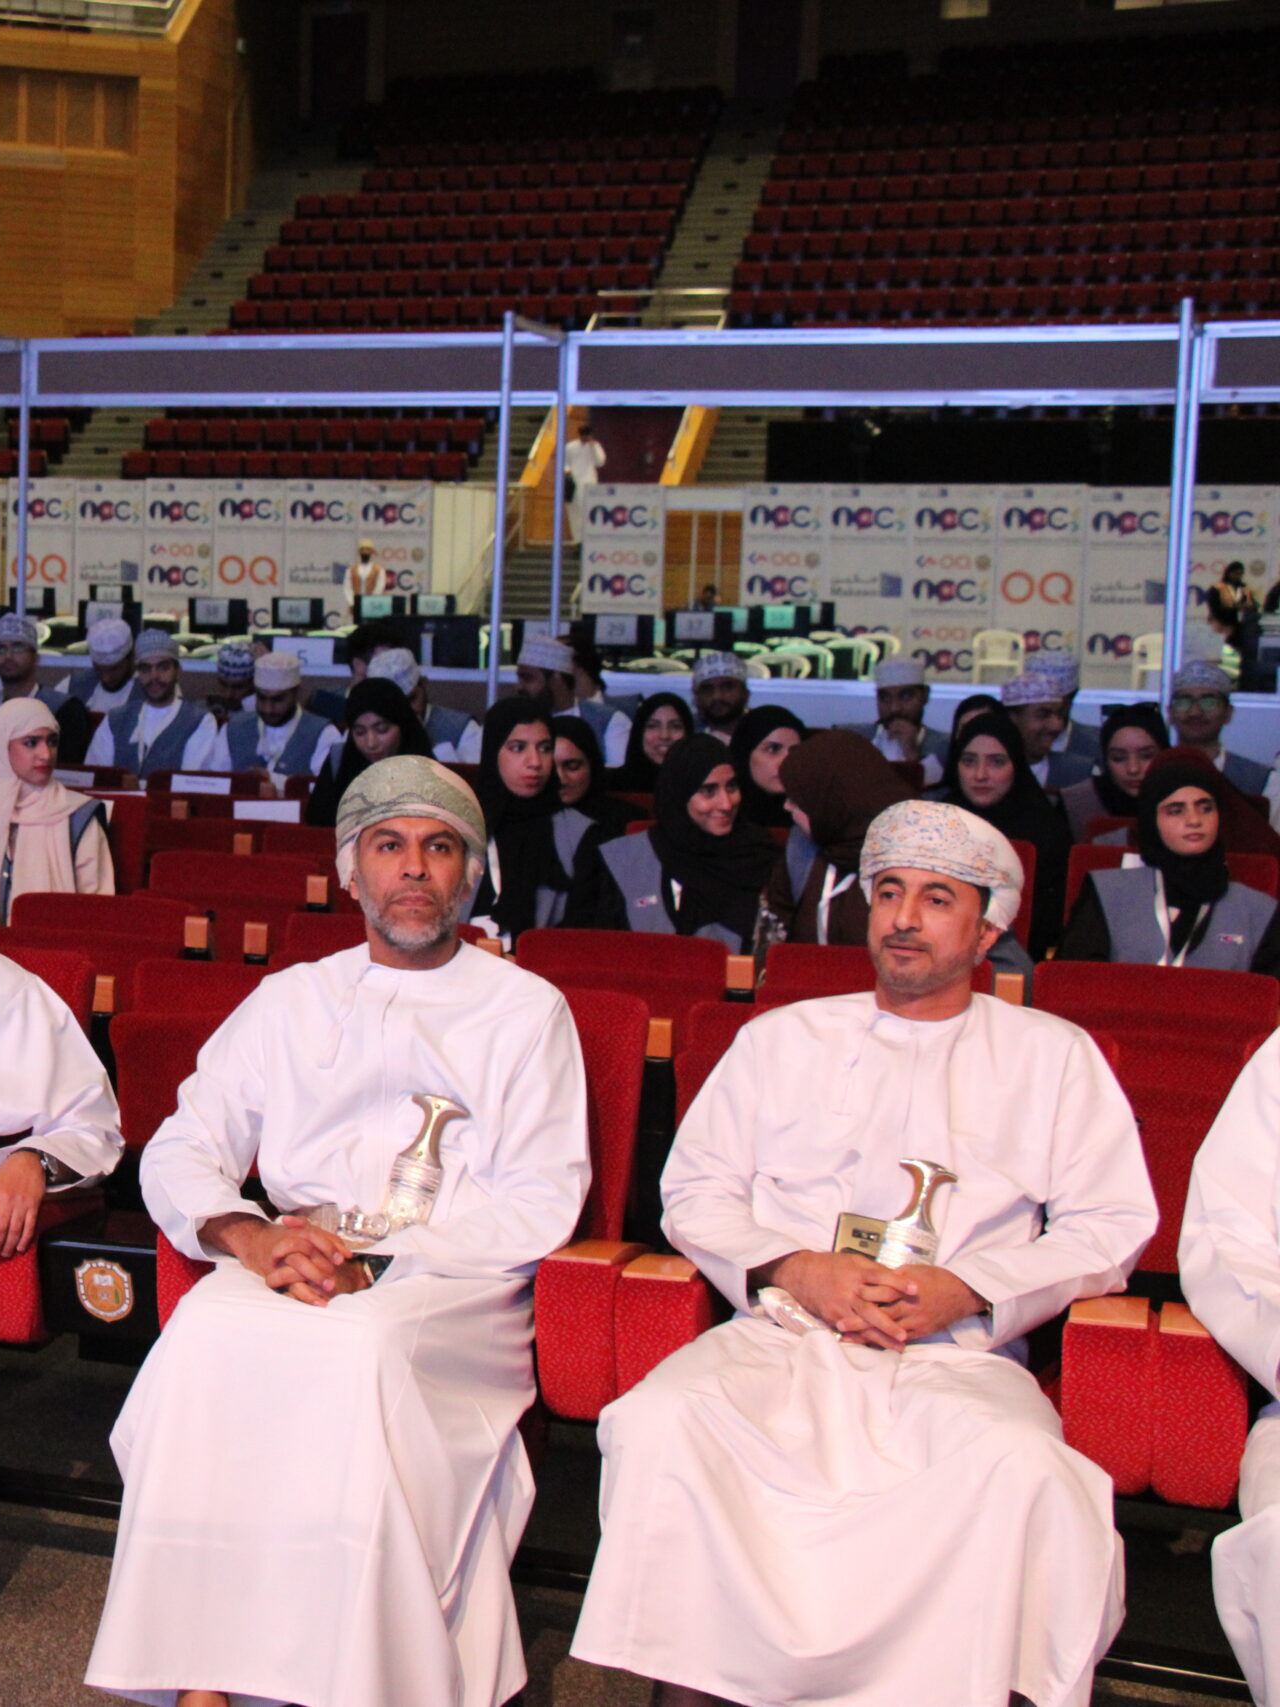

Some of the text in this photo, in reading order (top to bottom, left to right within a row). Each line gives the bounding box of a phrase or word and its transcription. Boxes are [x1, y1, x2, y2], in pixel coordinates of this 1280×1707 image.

[12, 554, 67, 584] OQ
[218, 555, 278, 586] OQ
[1001, 570, 1074, 605] OQ
